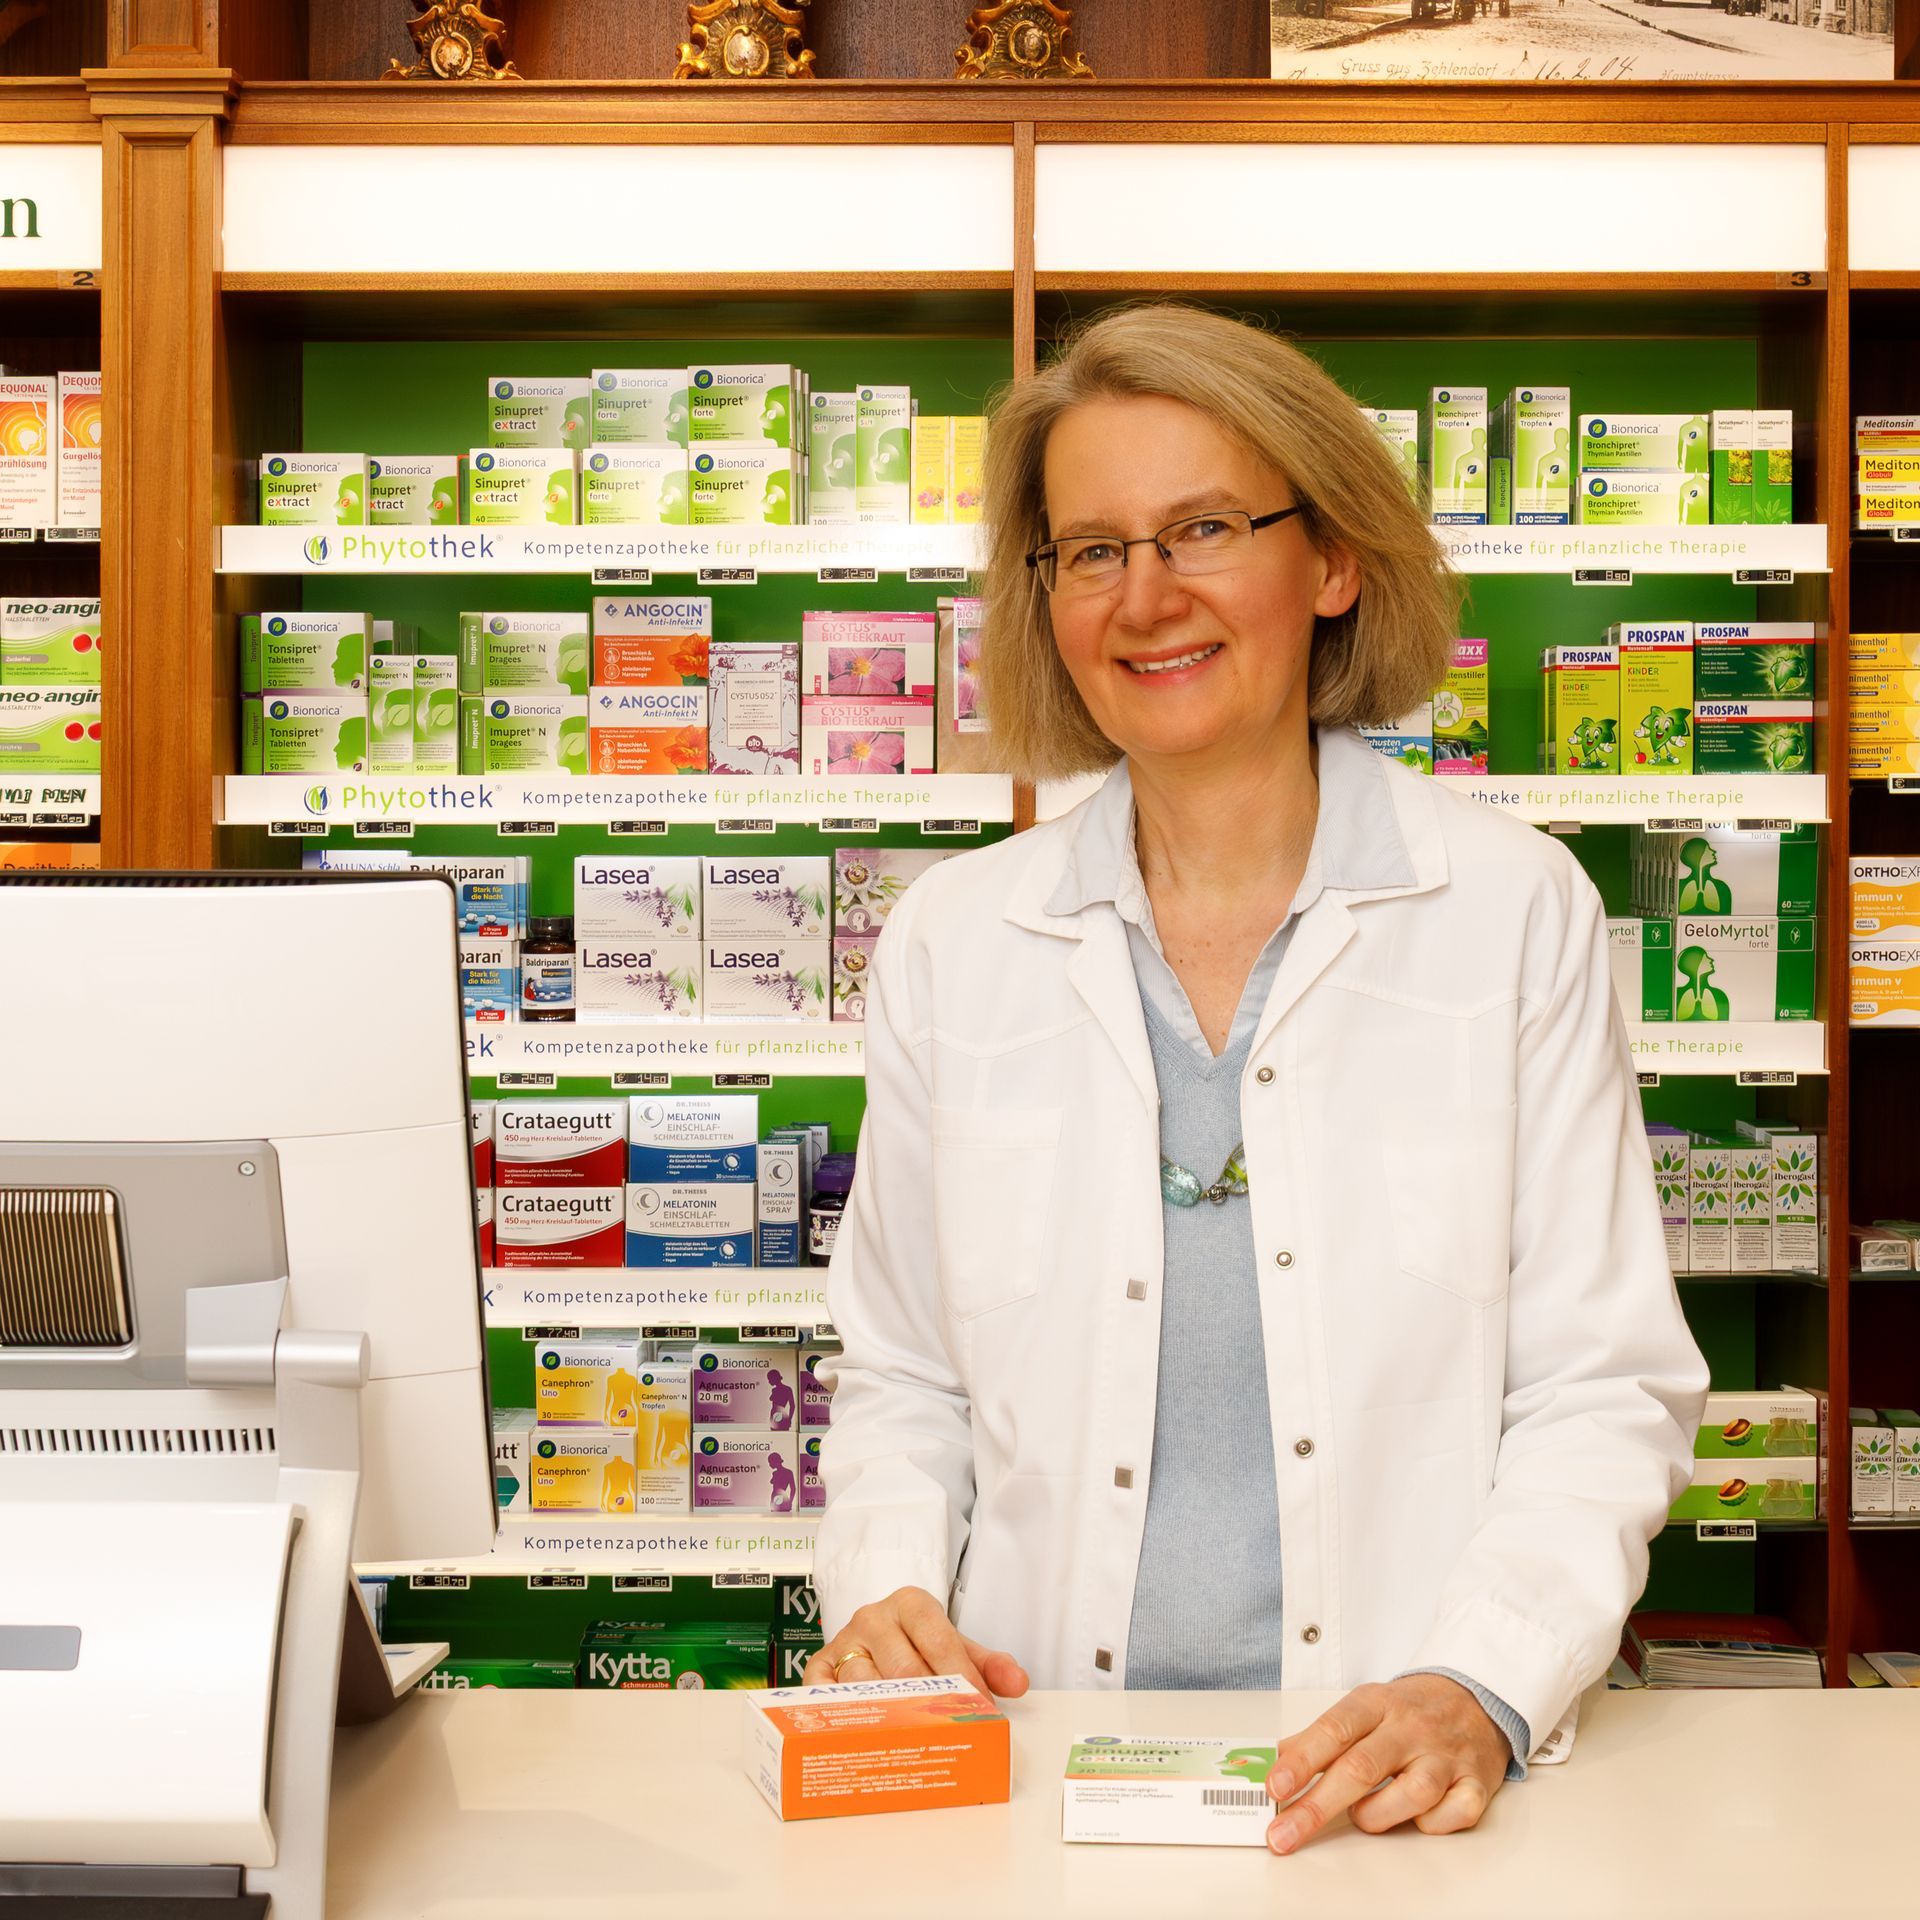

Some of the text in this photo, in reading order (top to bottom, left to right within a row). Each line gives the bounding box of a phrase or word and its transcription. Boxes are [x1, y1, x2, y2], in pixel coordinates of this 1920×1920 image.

[1341, 58, 1381, 77] Gruss
[1421, 60, 1499, 79] Zehlendorf
[73, 271, 94, 286] 2
[1790, 272, 1812, 286] 3
[621, 377, 668, 387] Bionorica
[717, 374, 764, 384] Bionorica
[0, 384, 48, 393] EQUONAL
[517, 386, 564, 396] Bionorica
[597, 399, 647, 412] Sinupret
[694, 396, 743, 409] Sinupret
[495, 405, 543, 419] Sinupret
[495, 420, 536, 430] extract
[1611, 424, 1658, 434] Bionorica
[1864, 420, 1914, 428] Meditonsin
[1587, 441, 1636, 450] Bronchipret
[63, 452, 101, 462] Gurgellös
[291, 462, 338, 472] Bionorica
[499, 458, 546, 468] Bionorica
[718, 459, 764, 468] Bionorica
[385, 465, 431, 475] Bionorica
[268, 483, 317, 496] Sinupret
[475, 478, 525, 491] Sinupret
[589, 480, 640, 493] Sinupret
[694, 480, 743, 493] Sinupret
[1612, 483, 1660, 493] Bionorica
[268, 497, 310, 507] extract
[475, 493, 518, 503] extract
[1588, 500, 1636, 509] Bronchipret
[0, 528, 29, 538] 10.60
[524, 540, 709, 558] Kompetenzapotheke
[716, 540, 742, 554] für
[749, 540, 848, 557] pflanzliche
[1530, 541, 1746, 558] für pflanzliche Therapie
[618, 570, 647, 580] 13.00
[722, 569, 752, 580] 27.50
[6, 601, 101, 618] neo-angi
[624, 604, 702, 617] ANGOCIN
[291, 622, 338, 632] Bionorica
[648, 618, 694, 626] Anti-Infekt
[1627, 630, 1684, 642] PROSPAN
[1701, 627, 1749, 637] PROSPAN
[846, 634, 906, 642] TEEKRAUT
[268, 644, 317, 658] Tonsipret
[489, 644, 531, 656] Imupret
[268, 656, 305, 664] Tabletten
[489, 656, 522, 664] Dragees
[1562, 652, 1612, 662] PROSPAN
[1627, 667, 1660, 675] KINDER
[619, 696, 698, 708] ANGOCIN
[293, 706, 340, 716] Bionorica
[514, 705, 561, 715] Bionorica
[643, 710, 688, 718] Anti-Infekt
[1700, 705, 1748, 716] PROSPAN
[846, 717, 904, 726] TEEKRAUT
[270, 728, 319, 742] Tonsipret
[490, 728, 531, 740] Imupret
[490, 739, 522, 748] Dragees
[523, 790, 707, 808] Kompetenzapotheke
[714, 790, 740, 803] für
[747, 790, 847, 806] pflanzliche
[854, 790, 931, 806] Therapie
[1527, 790, 1744, 807] für pflanzliche Therapie
[294, 823, 324, 833] 14.20
[954, 821, 976, 830] 8.20
[1854, 892, 1893, 902] immun
[1749, 940, 1769, 948] forte
[526, 958, 569, 968] Baldriparan
[1852, 976, 1891, 986] immun
[524, 1040, 848, 1056] Kompetenzapotheke für pflanzliche
[1667, 1040, 1744, 1056] Therapie
[521, 1074, 551, 1084] 24.90
[737, 1075, 767, 1085] 25.40
[666, 1112, 721, 1121] MELATONIN
[502, 1112, 612, 1133] Crataegutt
[667, 1124, 720, 1132] EINSCHLAF-
[1656, 1174, 1686, 1182] erogast
[1774, 1173, 1815, 1181] Iberogast
[1692, 1182, 1728, 1190] Iberogast
[502, 1195, 612, 1216] Crataegutt
[524, 1290, 824, 1306] Kompetenzapotheke für pflanzlic
[547, 1328, 577, 1338] 77.40
[564, 1357, 611, 1366] Bionorica
[722, 1358, 770, 1368] Bionorica
[542, 1379, 590, 1388] Canephron
[700, 1380, 757, 1390] Agnucaston
[714, 1394, 728, 1403] mg
[560, 1445, 608, 1454] Bionorica
[723, 1442, 770, 1451] Bionorica
[538, 1468, 587, 1477] Canephron
[700, 1464, 758, 1474] Agnucaston
[524, 1536, 740, 1553] Kompetenzapotheke für
[552, 1576, 582, 1586] 25.70
[590, 1652, 670, 1687] Kytta
[808, 1678, 954, 1696] ANGOCIN
